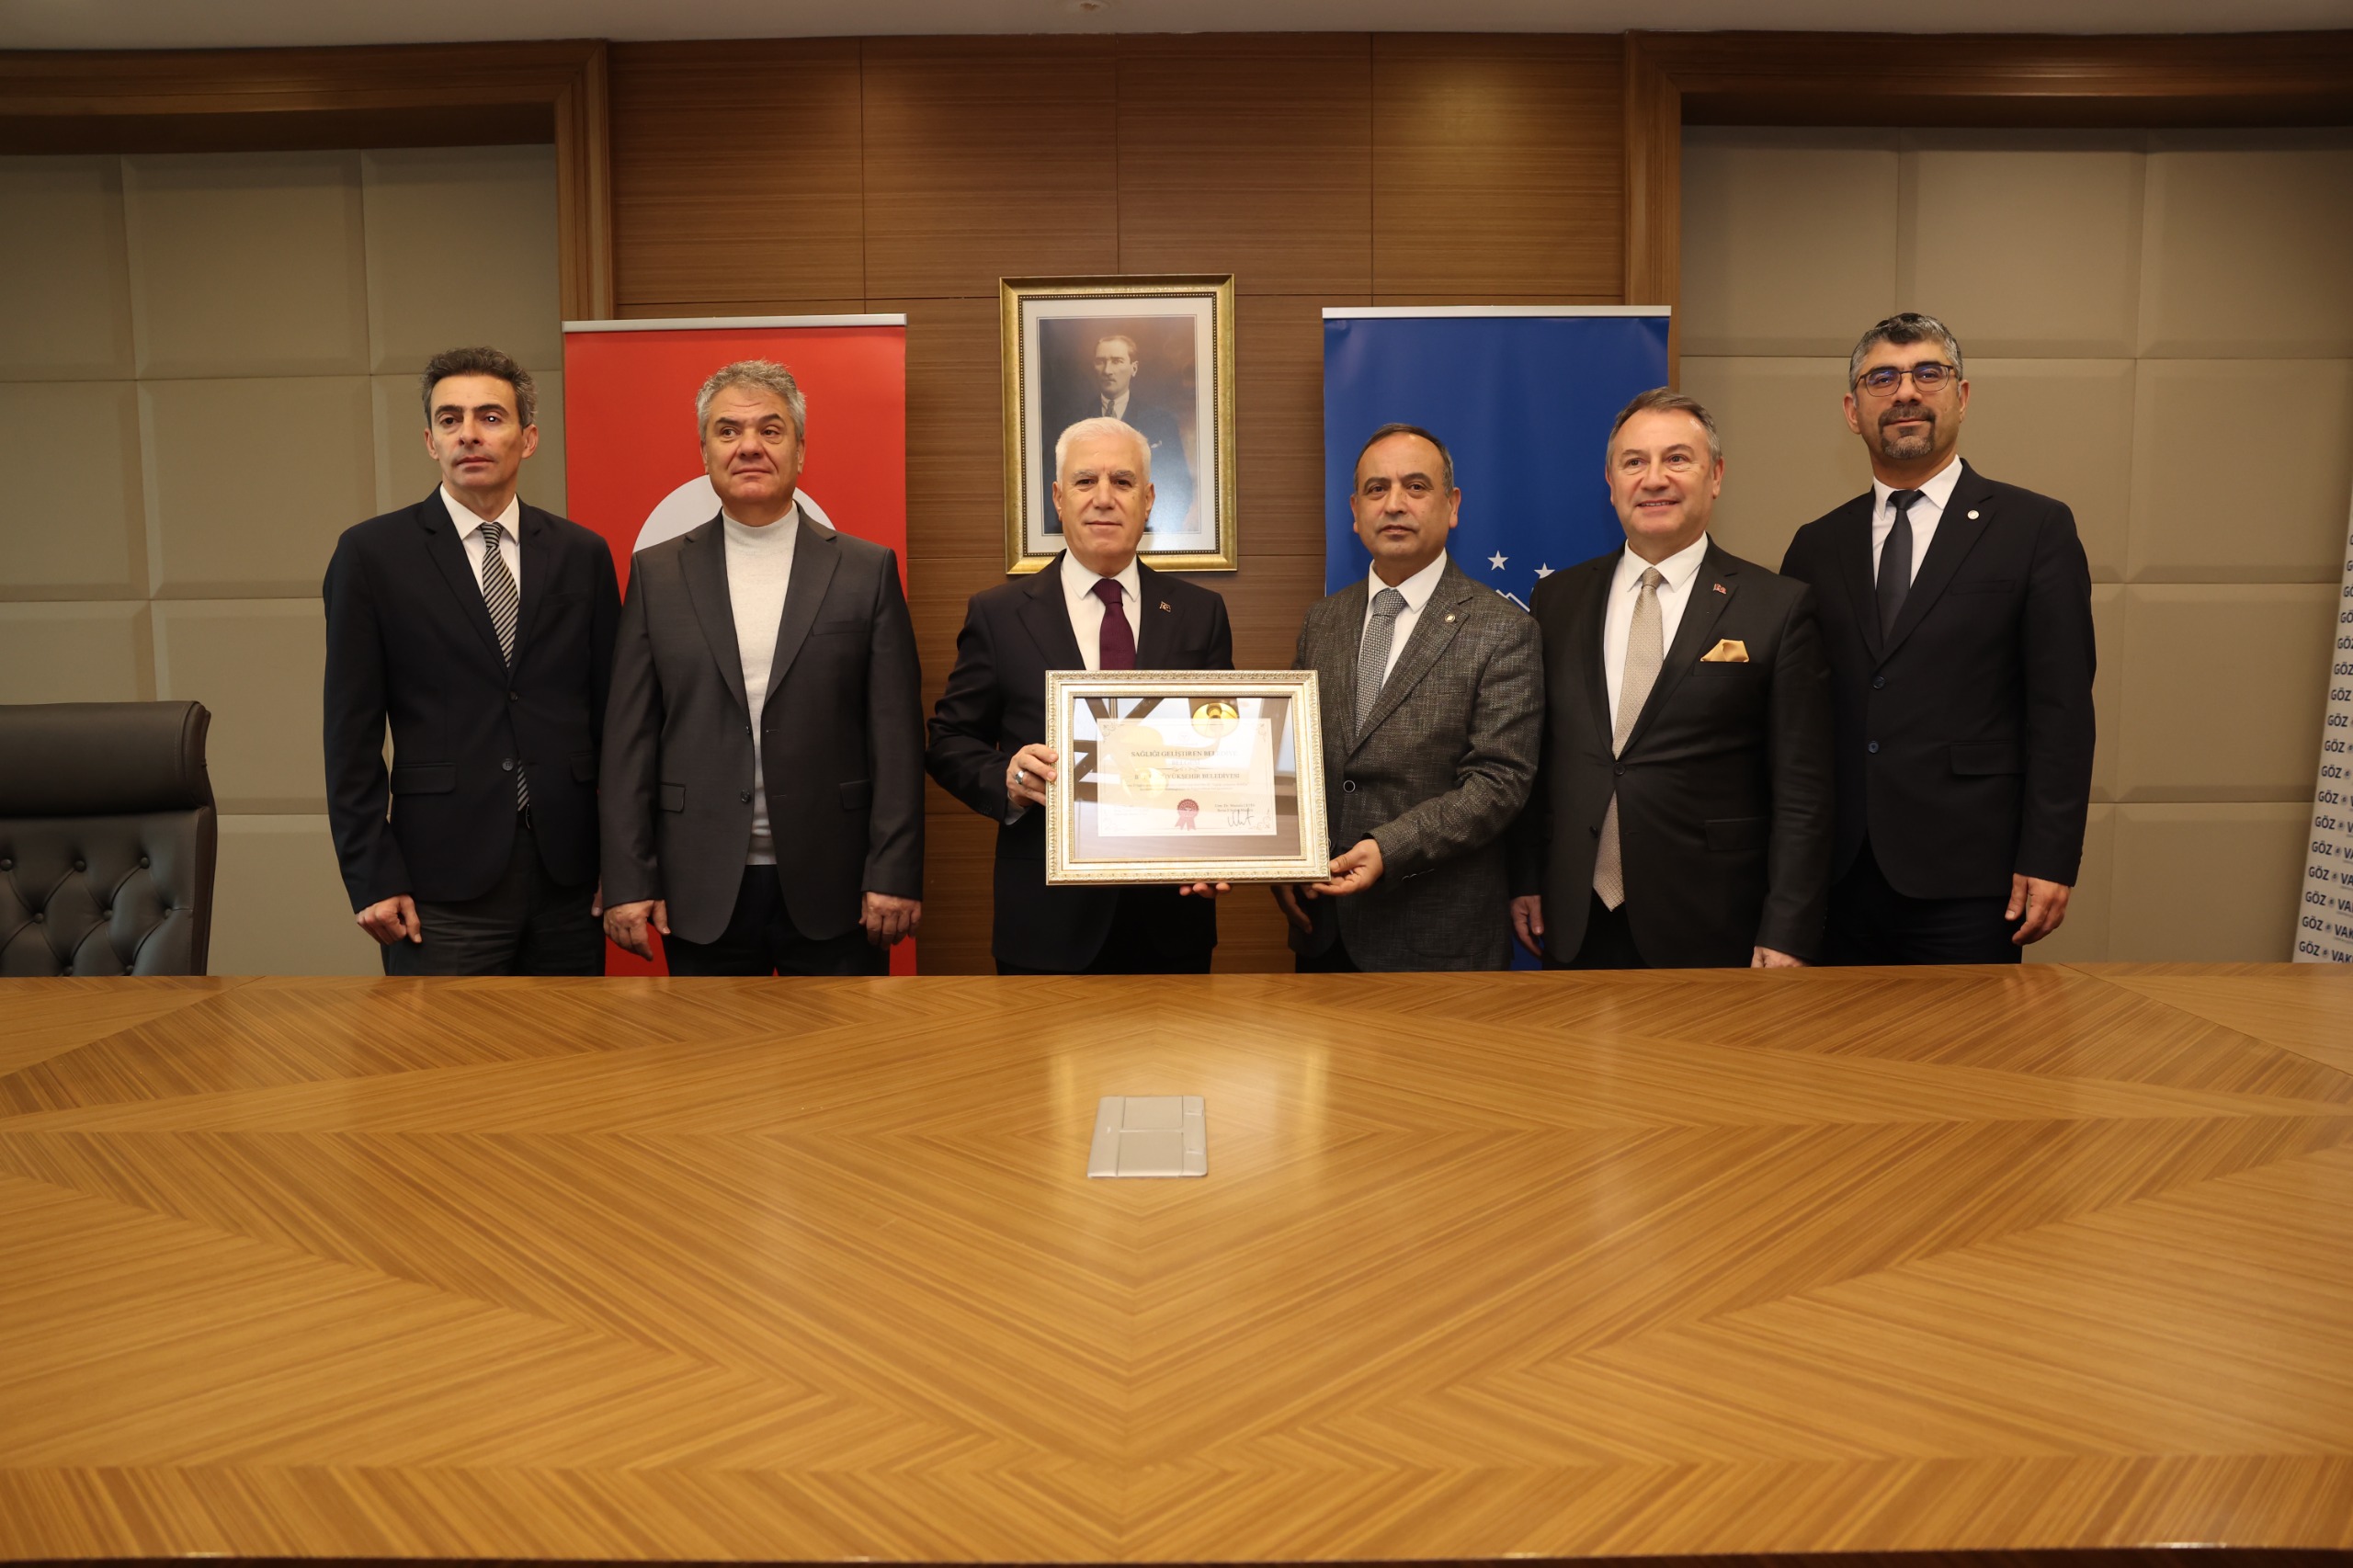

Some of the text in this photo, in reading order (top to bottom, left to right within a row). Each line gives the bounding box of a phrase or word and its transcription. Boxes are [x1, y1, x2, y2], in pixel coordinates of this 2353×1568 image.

[2334, 662, 2353, 676] GÖZ
[2331, 687, 2352, 701] GÖZ
[2327, 712, 2348, 727] GÖZ
[2325, 738, 2346, 753] GÖZ
[2321, 764, 2342, 778] GÖZ
[2318, 790, 2339, 804] GÖZ
[2315, 815, 2336, 830] GÖZ
[2312, 840, 2333, 856] GÖZ
[2308, 865, 2330, 881] GÖZ
[2305, 890, 2327, 905] GÖZ
[2302, 915, 2324, 931] GÖZ
[2299, 939, 2320, 956] GÖZ
